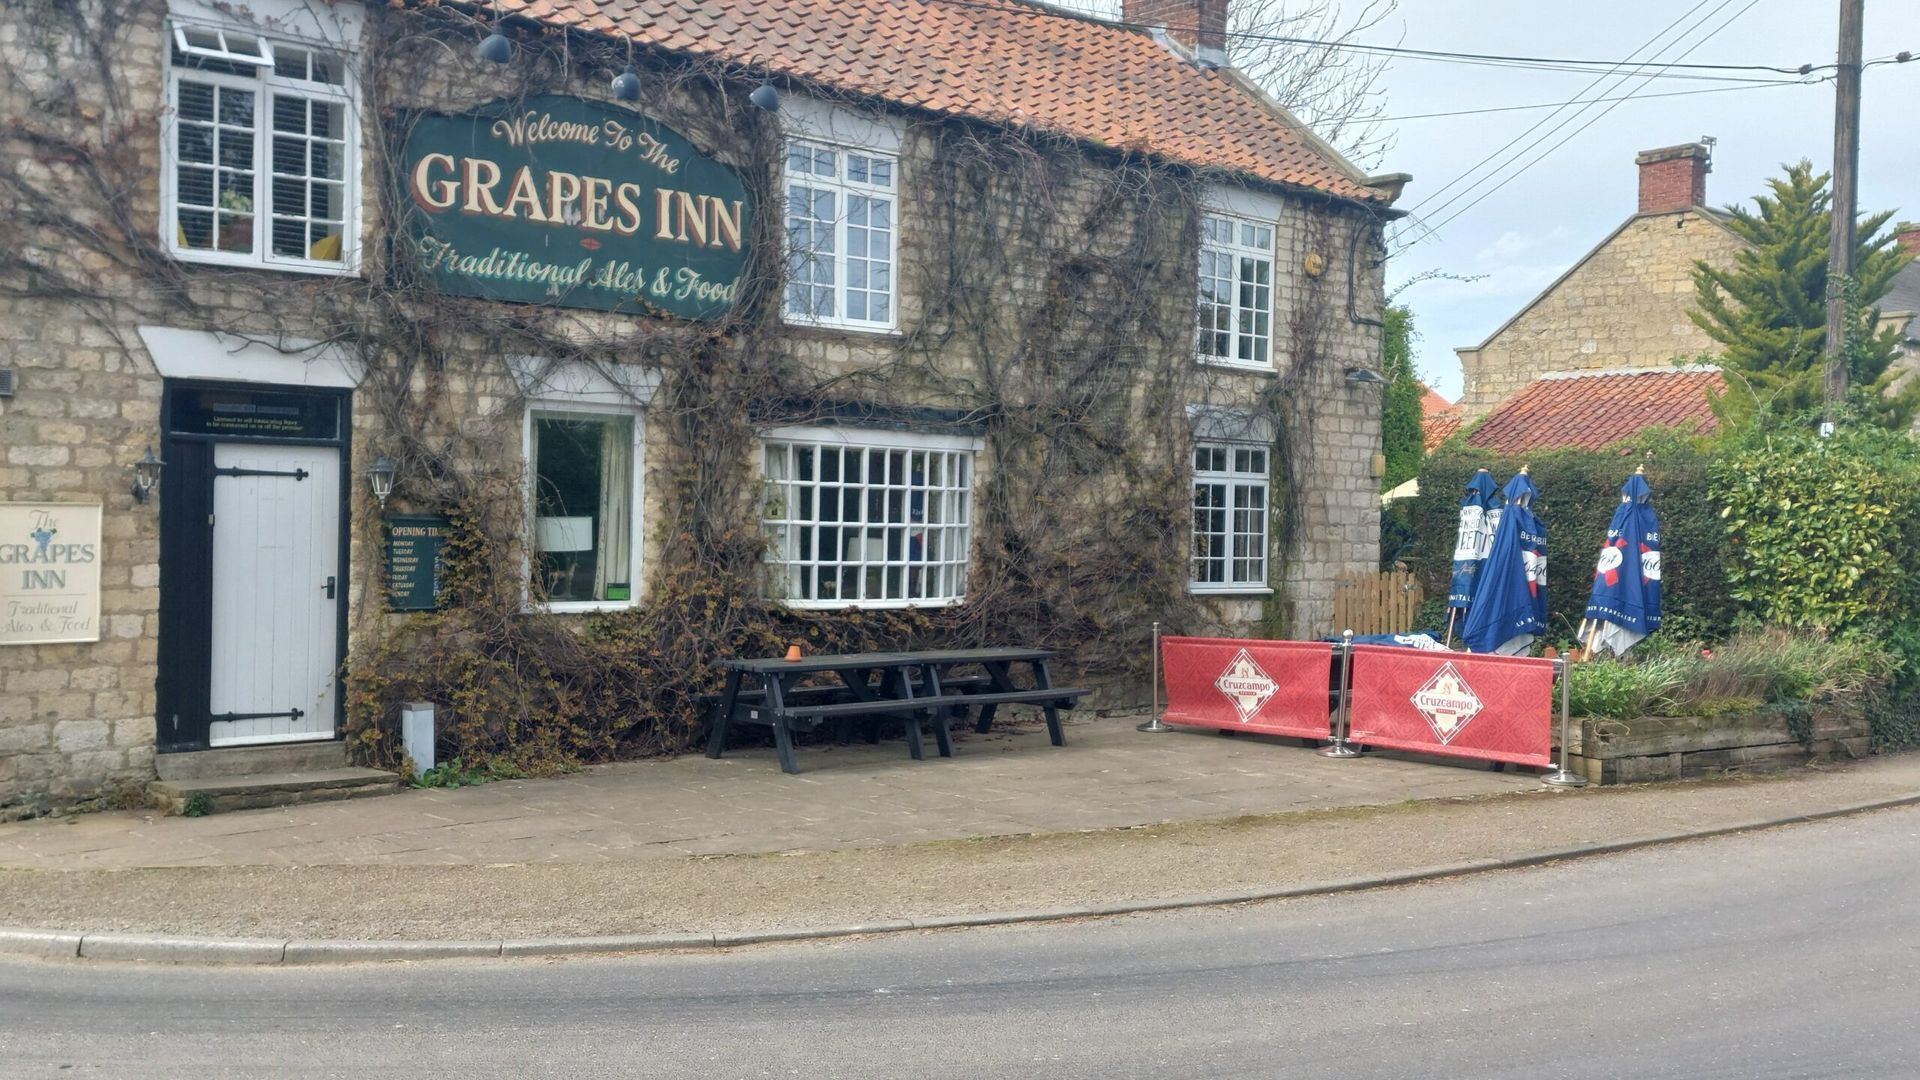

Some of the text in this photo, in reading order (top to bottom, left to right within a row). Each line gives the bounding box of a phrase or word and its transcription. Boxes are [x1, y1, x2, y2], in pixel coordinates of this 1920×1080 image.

[492, 110, 680, 175] Welcome To The
[411, 153, 744, 253] GRAPES INN
[420, 235, 742, 303] Traditional Ales & Food
[29, 509, 59, 530] The
[392, 526, 426, 537] OPENING
[0, 543, 95, 565] GRAPES
[21, 569, 66, 590] INN
[8, 600, 78, 617] Traditional
[40, 618, 52, 633] &
[56, 616, 90, 634] Food
[1223, 679, 1271, 692] Cruzcampo
[1420, 694, 1473, 711] Cruzcampo
